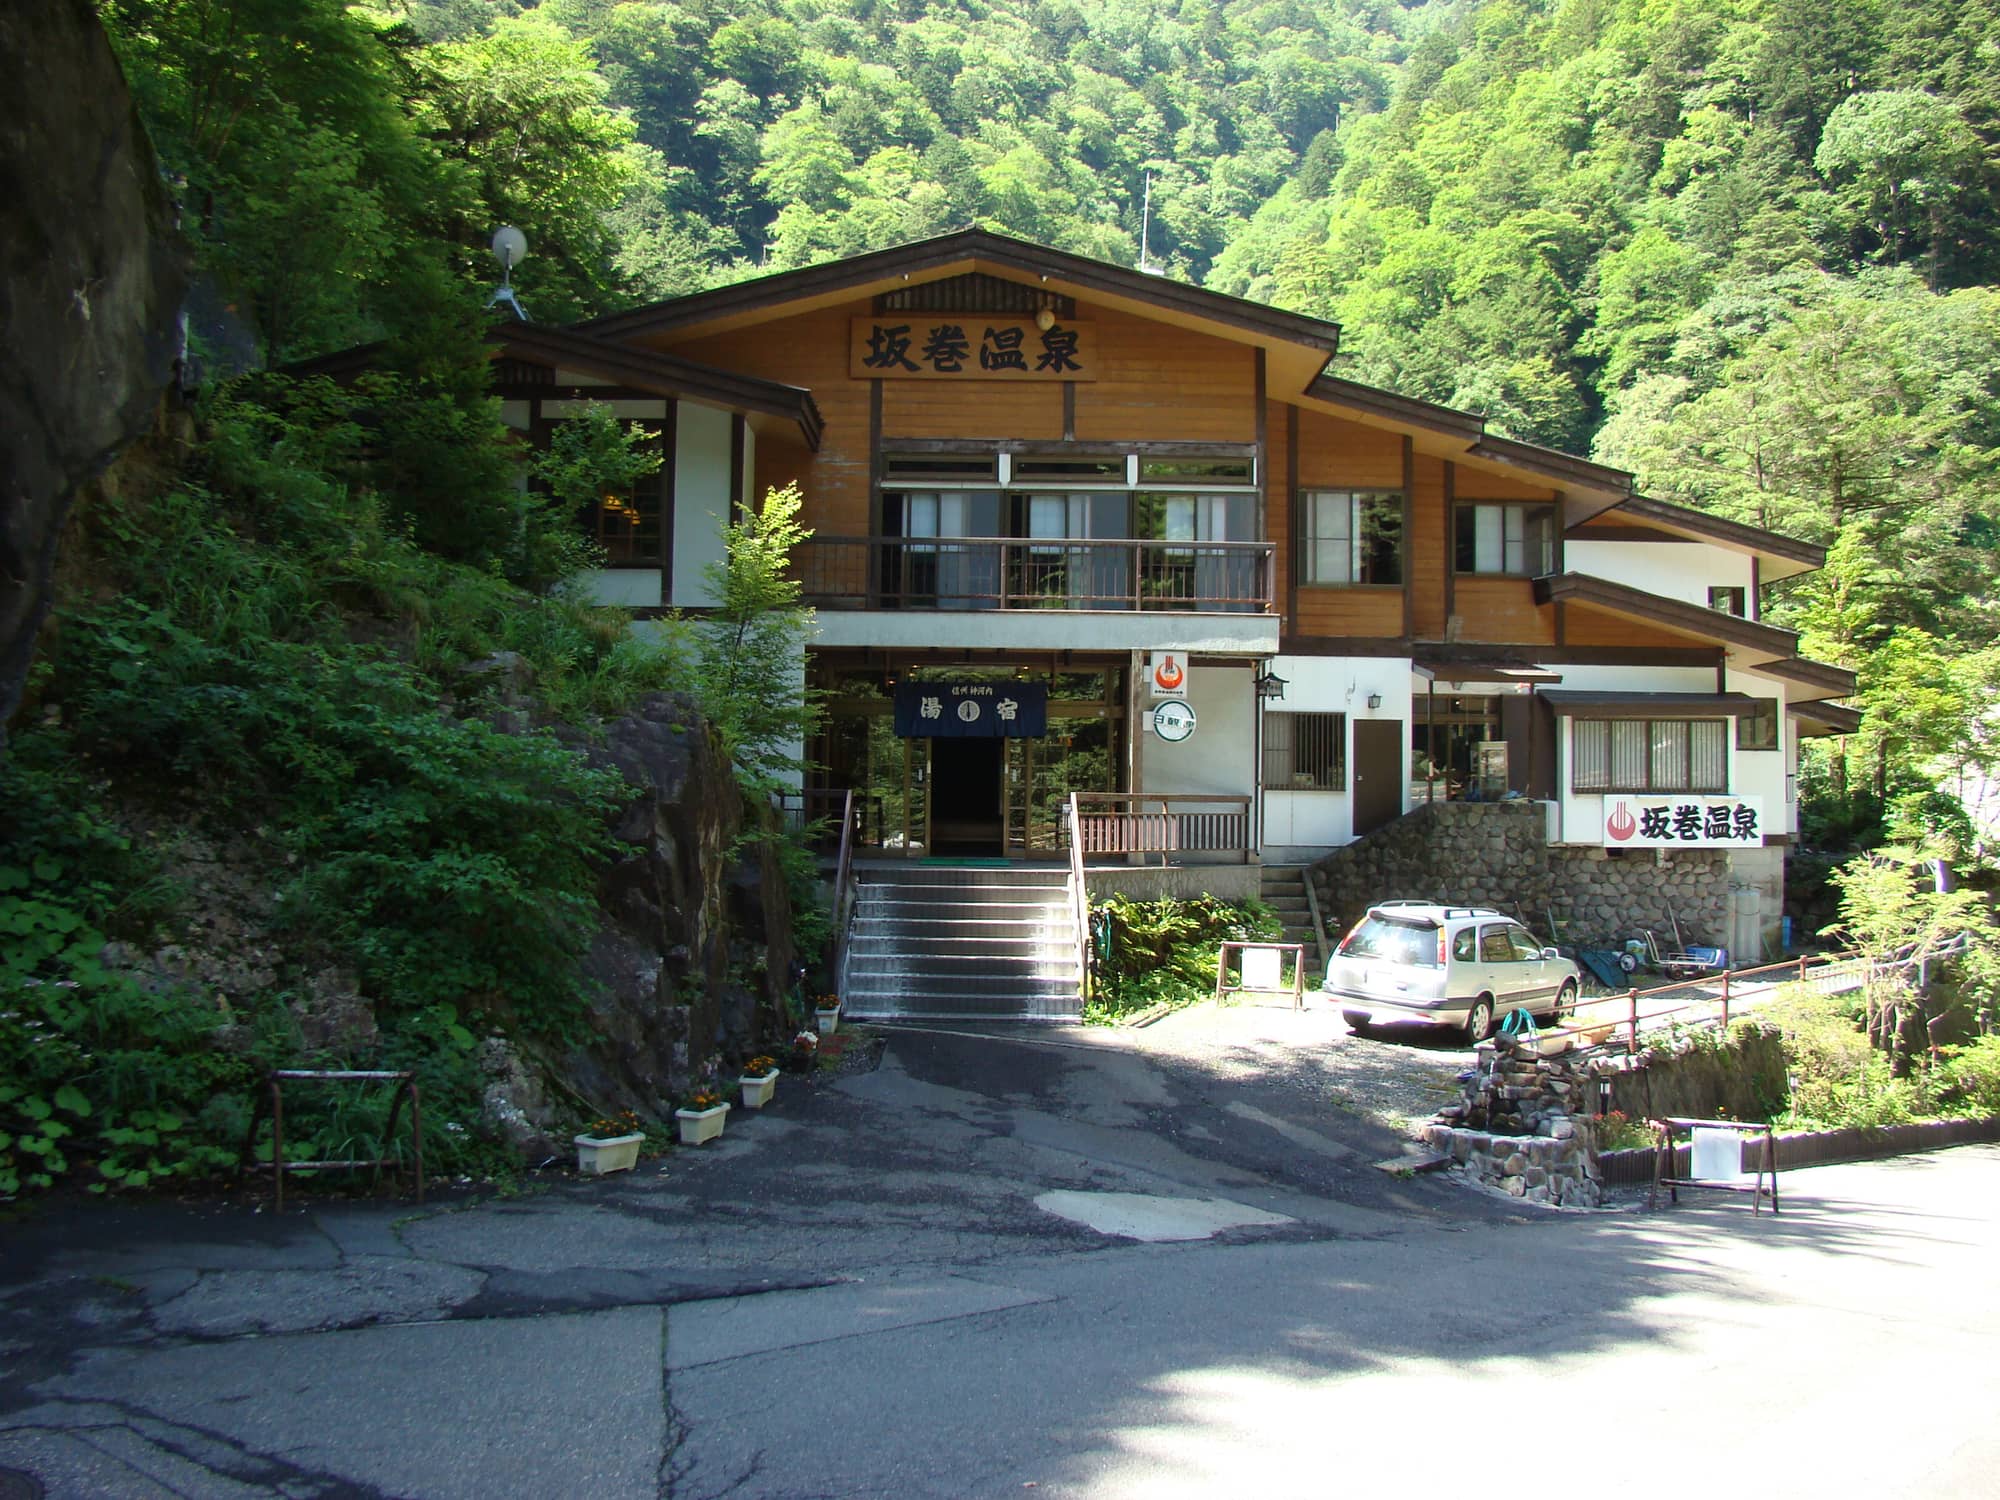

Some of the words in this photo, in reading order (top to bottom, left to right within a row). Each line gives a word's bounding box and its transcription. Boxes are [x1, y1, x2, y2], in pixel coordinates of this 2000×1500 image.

[863, 324, 1083, 373] 坂巻温泉
[921, 697, 943, 719] 湯
[996, 698, 1018, 720] 宿
[1639, 804, 1759, 841] 坂巻温泉
